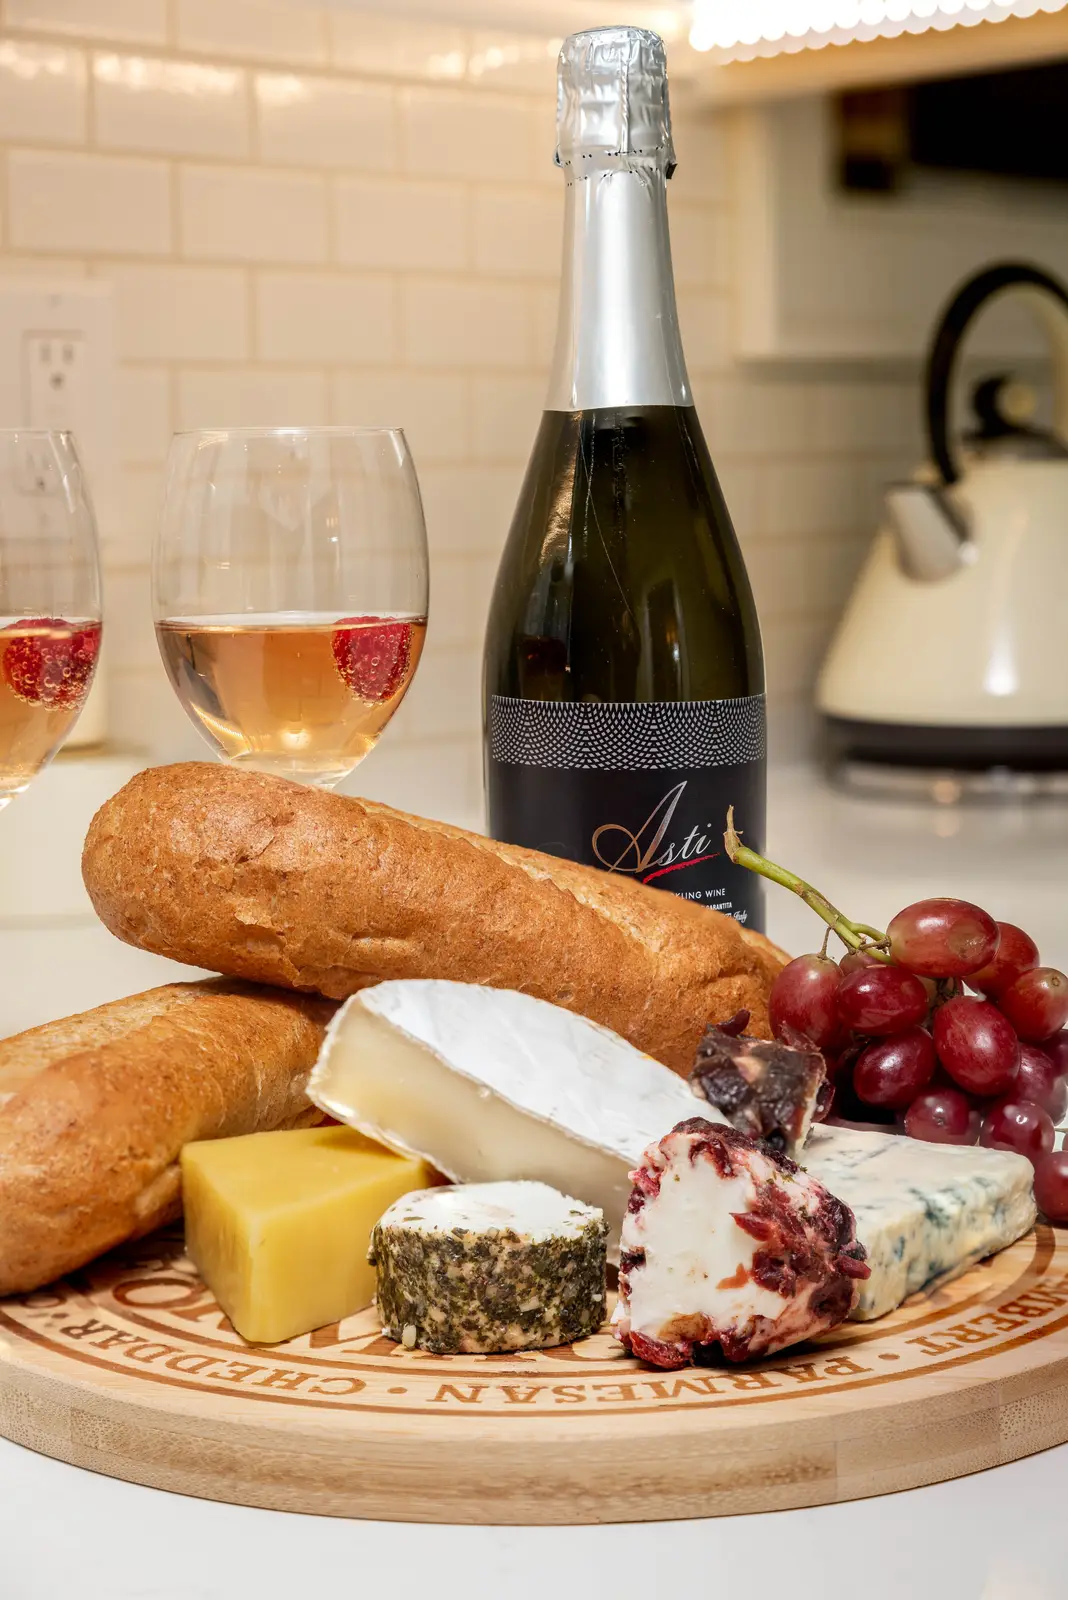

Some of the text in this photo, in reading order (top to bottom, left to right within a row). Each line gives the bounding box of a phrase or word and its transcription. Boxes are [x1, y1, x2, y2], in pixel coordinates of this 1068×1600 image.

[592, 780, 712, 873] Asti
[705, 888, 726, 898] WINE
[59, 1318, 367, 1396] CHEDDAR
[426, 1355, 874, 1404] PARMESAN
